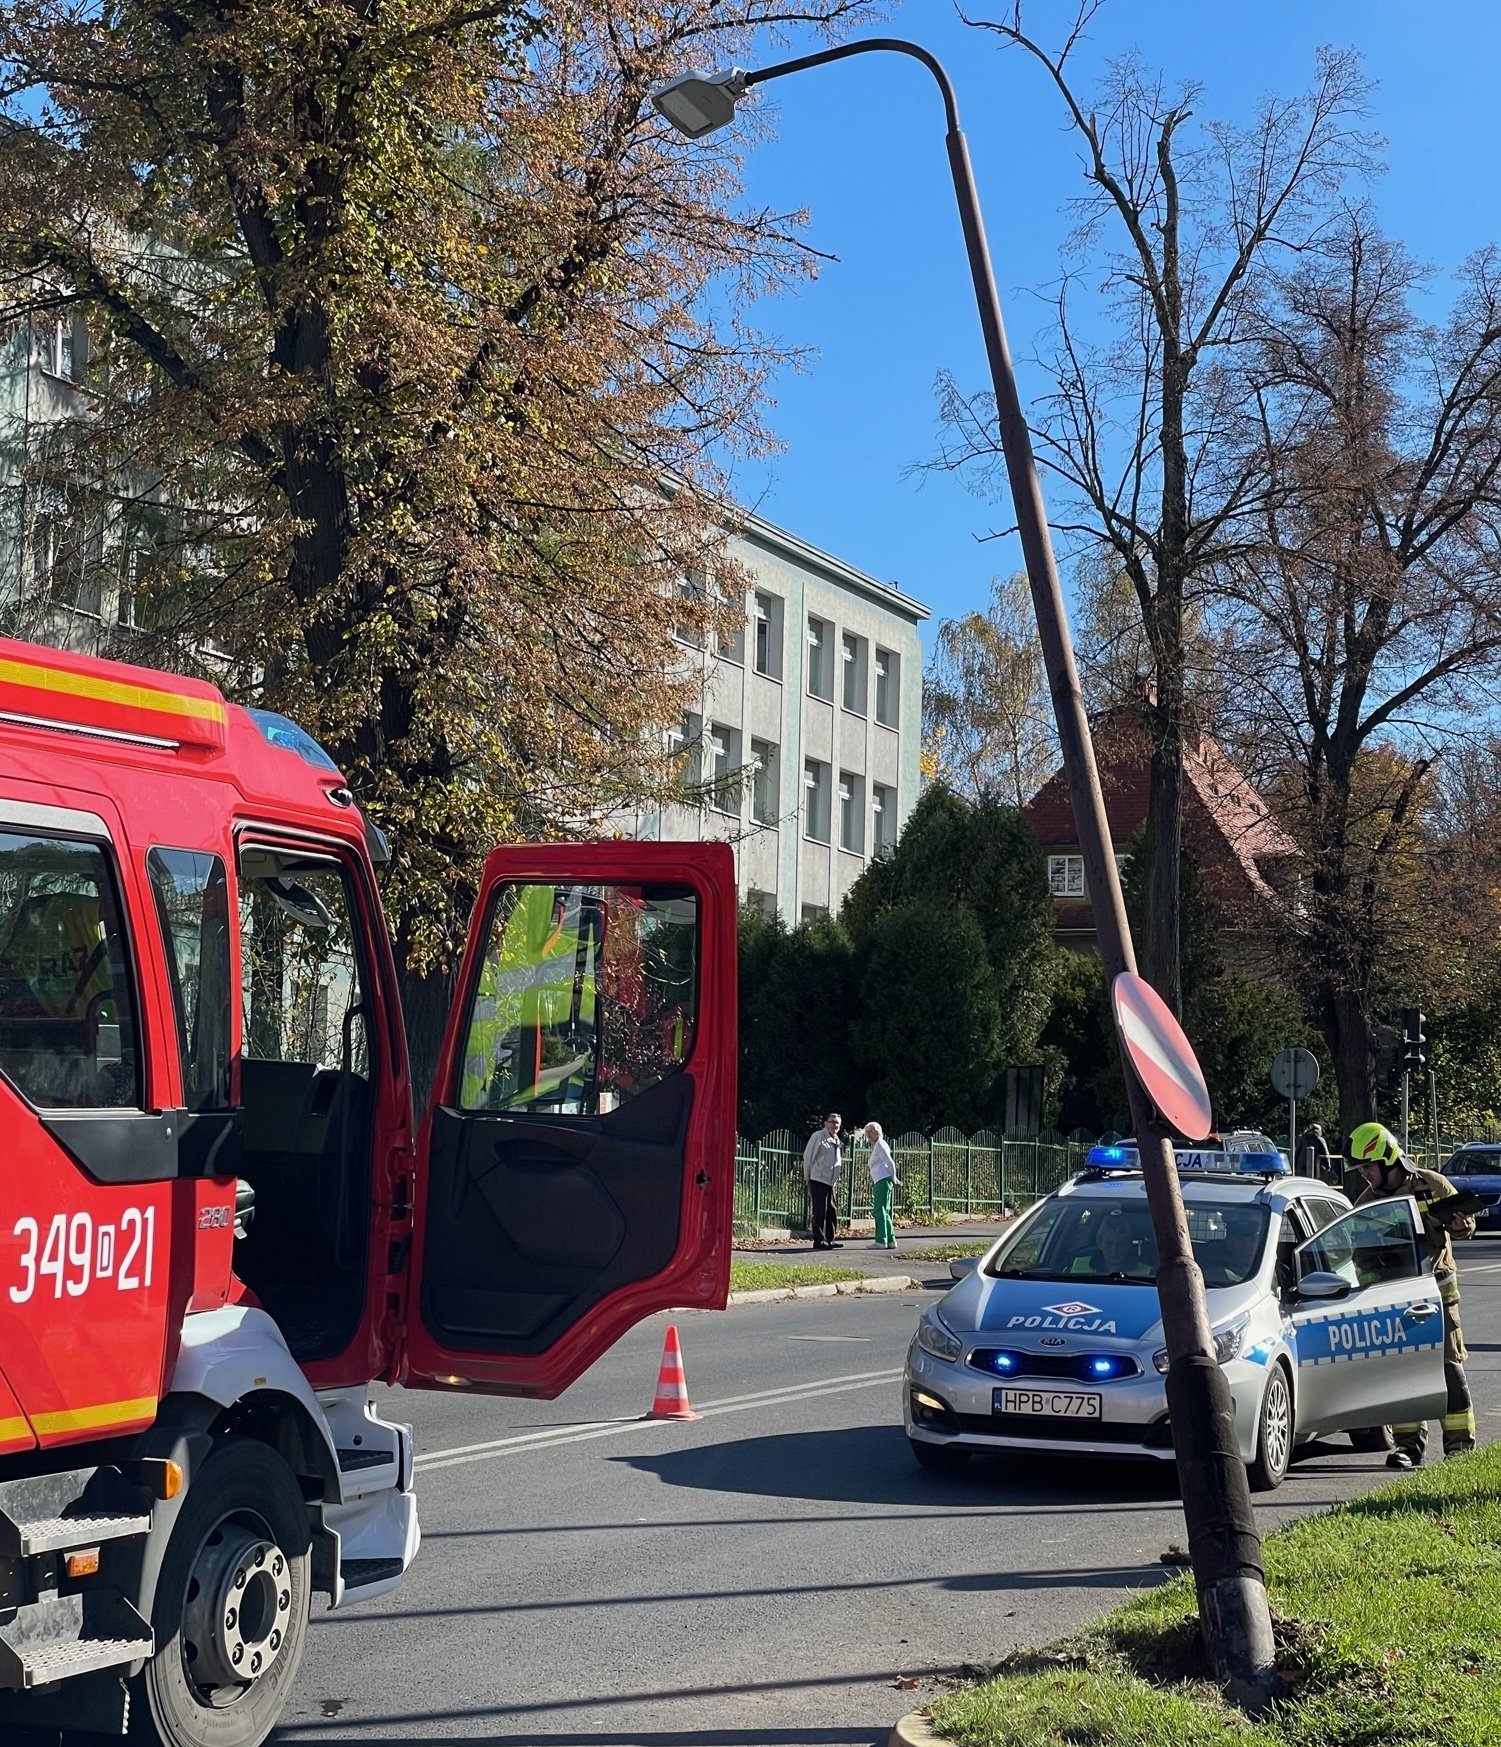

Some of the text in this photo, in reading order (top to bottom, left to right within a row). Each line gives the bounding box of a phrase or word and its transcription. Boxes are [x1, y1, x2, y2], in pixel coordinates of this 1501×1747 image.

[198, 1205, 231, 1229] 280
[1006, 1316, 1117, 1333] POLICJA
[1328, 1317, 1407, 1351] POLICJA
[1043, 1337, 1062, 1345] KIA
[1005, 1392, 1096, 1415] HPB C775
